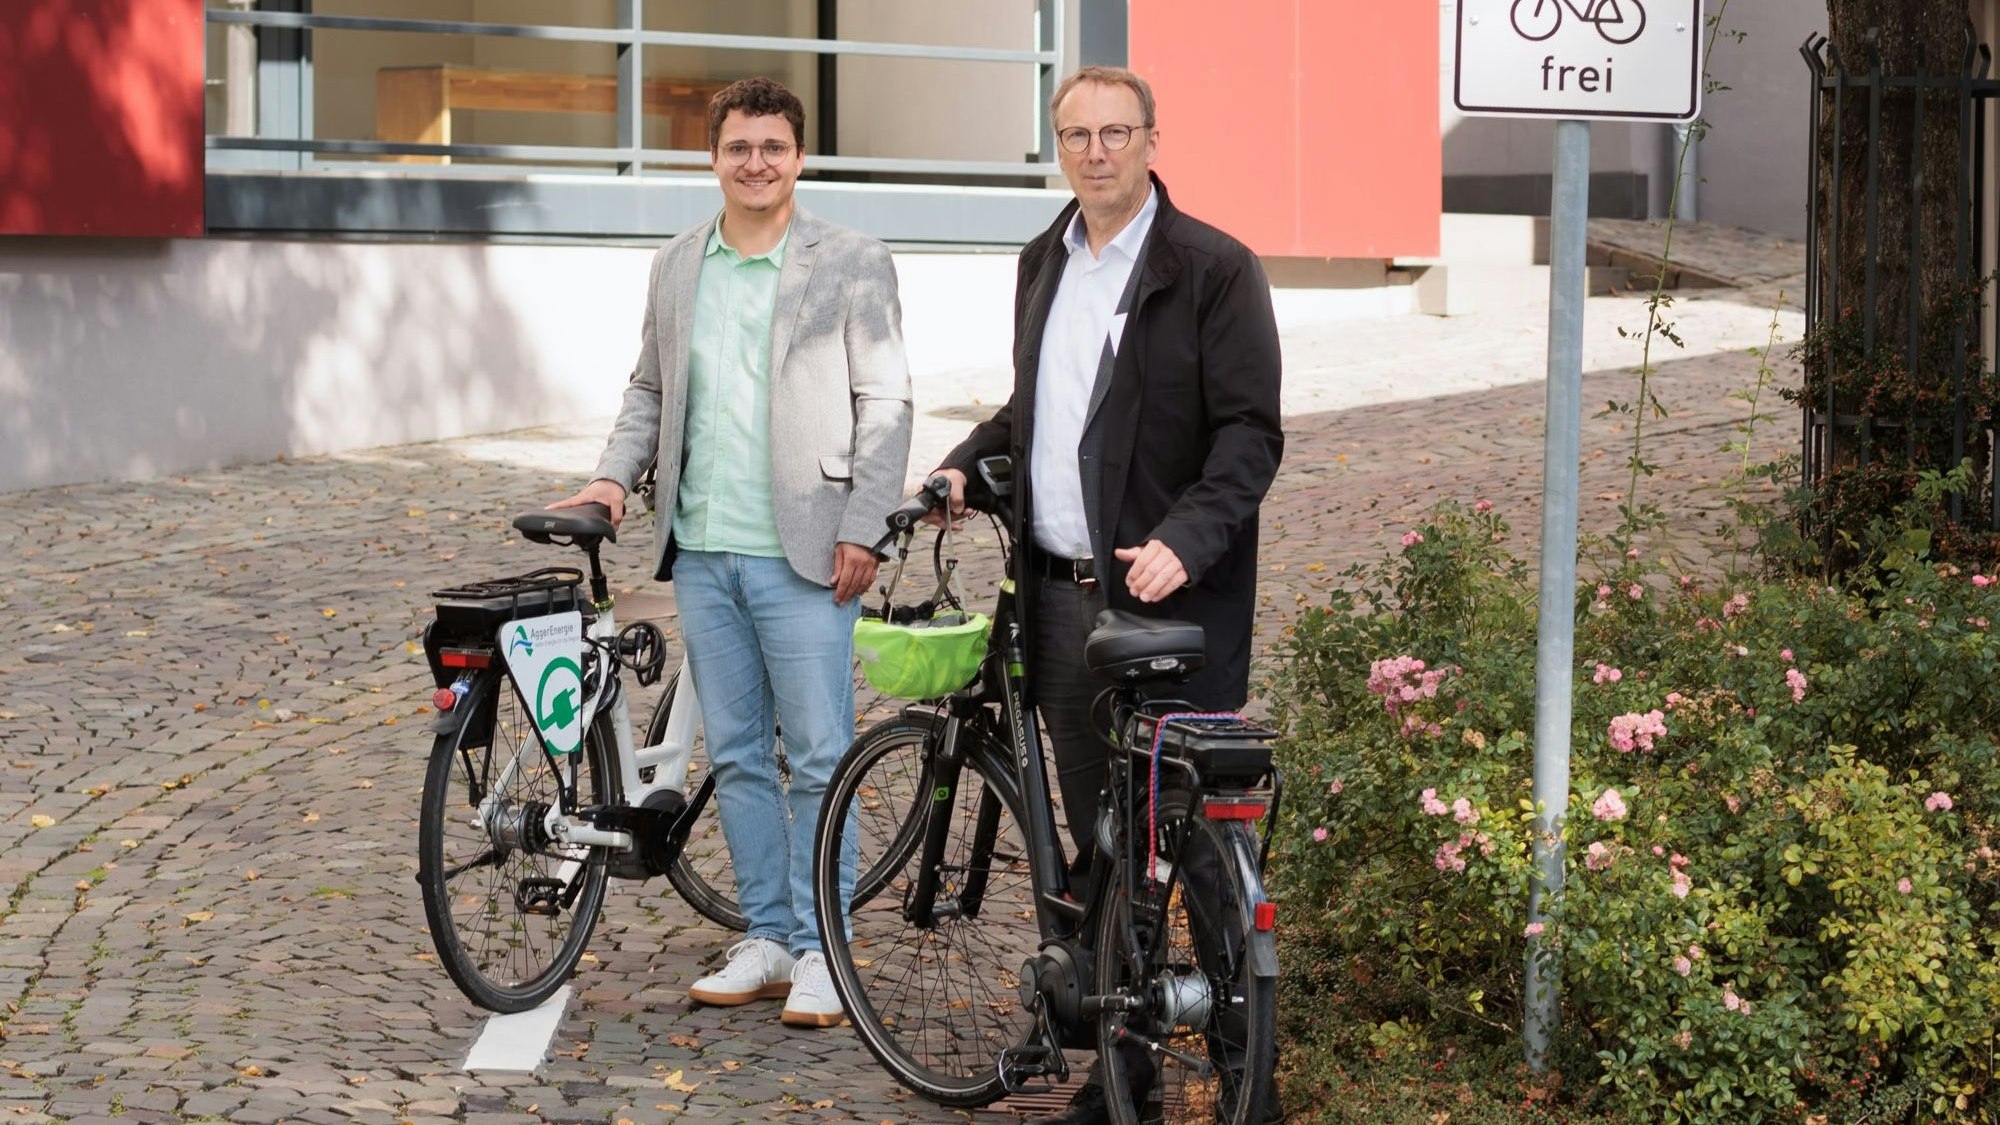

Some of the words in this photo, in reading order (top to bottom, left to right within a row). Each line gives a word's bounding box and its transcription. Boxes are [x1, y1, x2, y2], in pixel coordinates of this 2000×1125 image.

[1541, 56, 1612, 93] frei
[530, 623, 574, 640] AggerEnergie
[1012, 691, 1028, 757] PEGASUS
